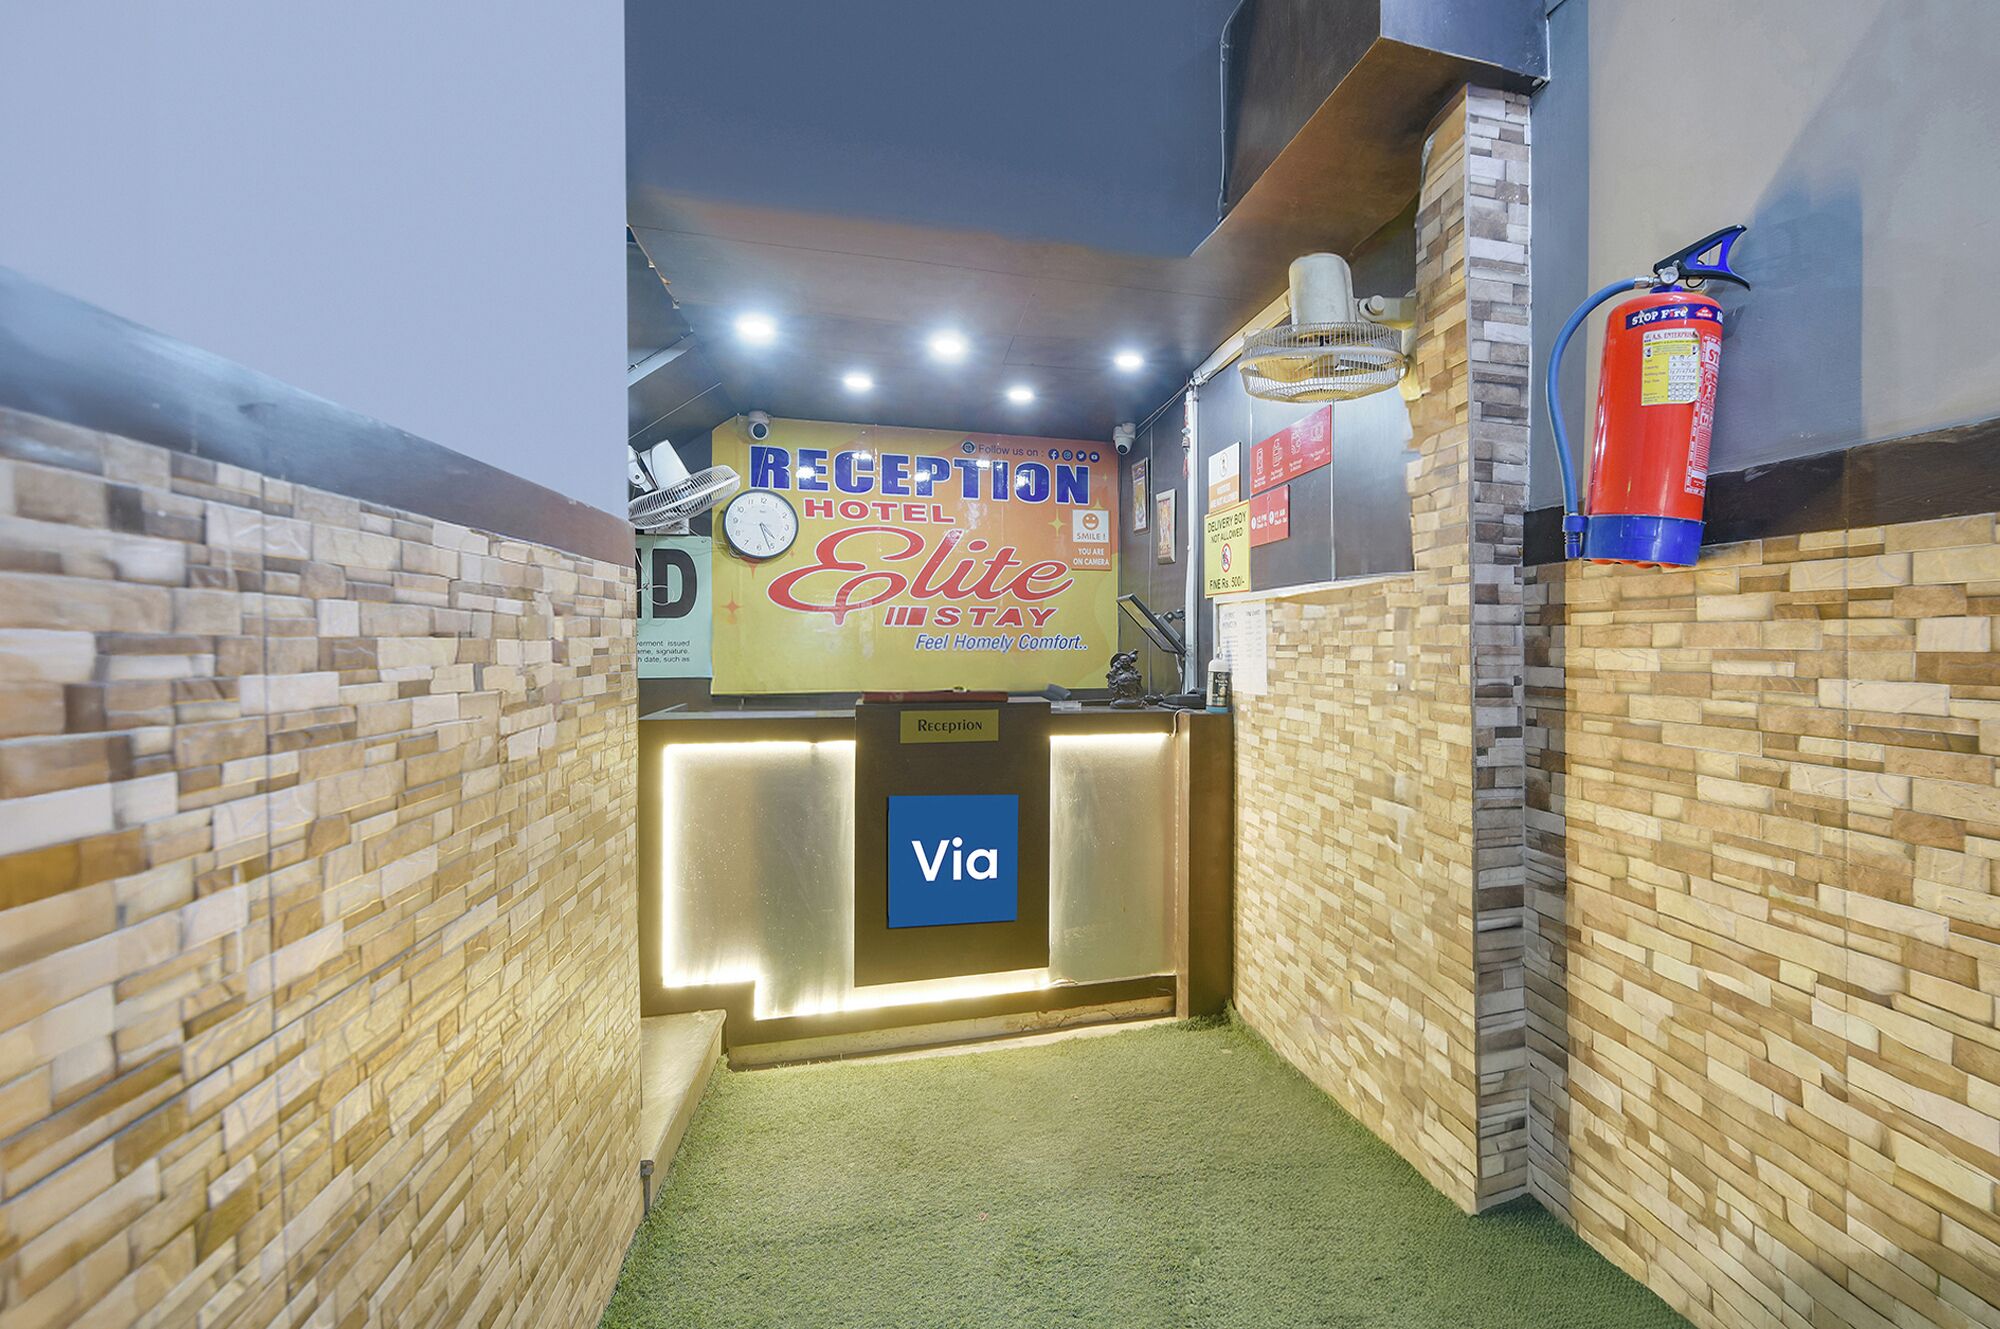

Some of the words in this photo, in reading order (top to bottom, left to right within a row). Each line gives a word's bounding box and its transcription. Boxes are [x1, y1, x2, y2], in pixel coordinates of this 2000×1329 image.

[1631, 310, 1658, 325] STOP
[978, 444, 1010, 455] Follow
[1012, 448, 1024, 456] us
[1026, 449, 1039, 457] on
[749, 445, 1090, 504] RECEPTION
[804, 499, 955, 524] HOTEL
[1207, 515, 1233, 533] DELIVERY
[1234, 511, 1247, 526] BOY
[1211, 533, 1220, 543] NOT
[1220, 527, 1243, 541] ALLOWED
[1078, 548, 1092, 556] YOU
[1093, 548, 1104, 556] ARE
[1073, 558, 1082, 566] ON
[1083, 558, 1109, 566] CAMERA
[767, 525, 1074, 625] Elite
[1210, 579, 1221, 591] FINE
[934, 606, 1057, 627] STAY
[915, 634, 949, 650] Feel
[953, 634, 1013, 653] Homely
[911, 836, 998, 882] Via
